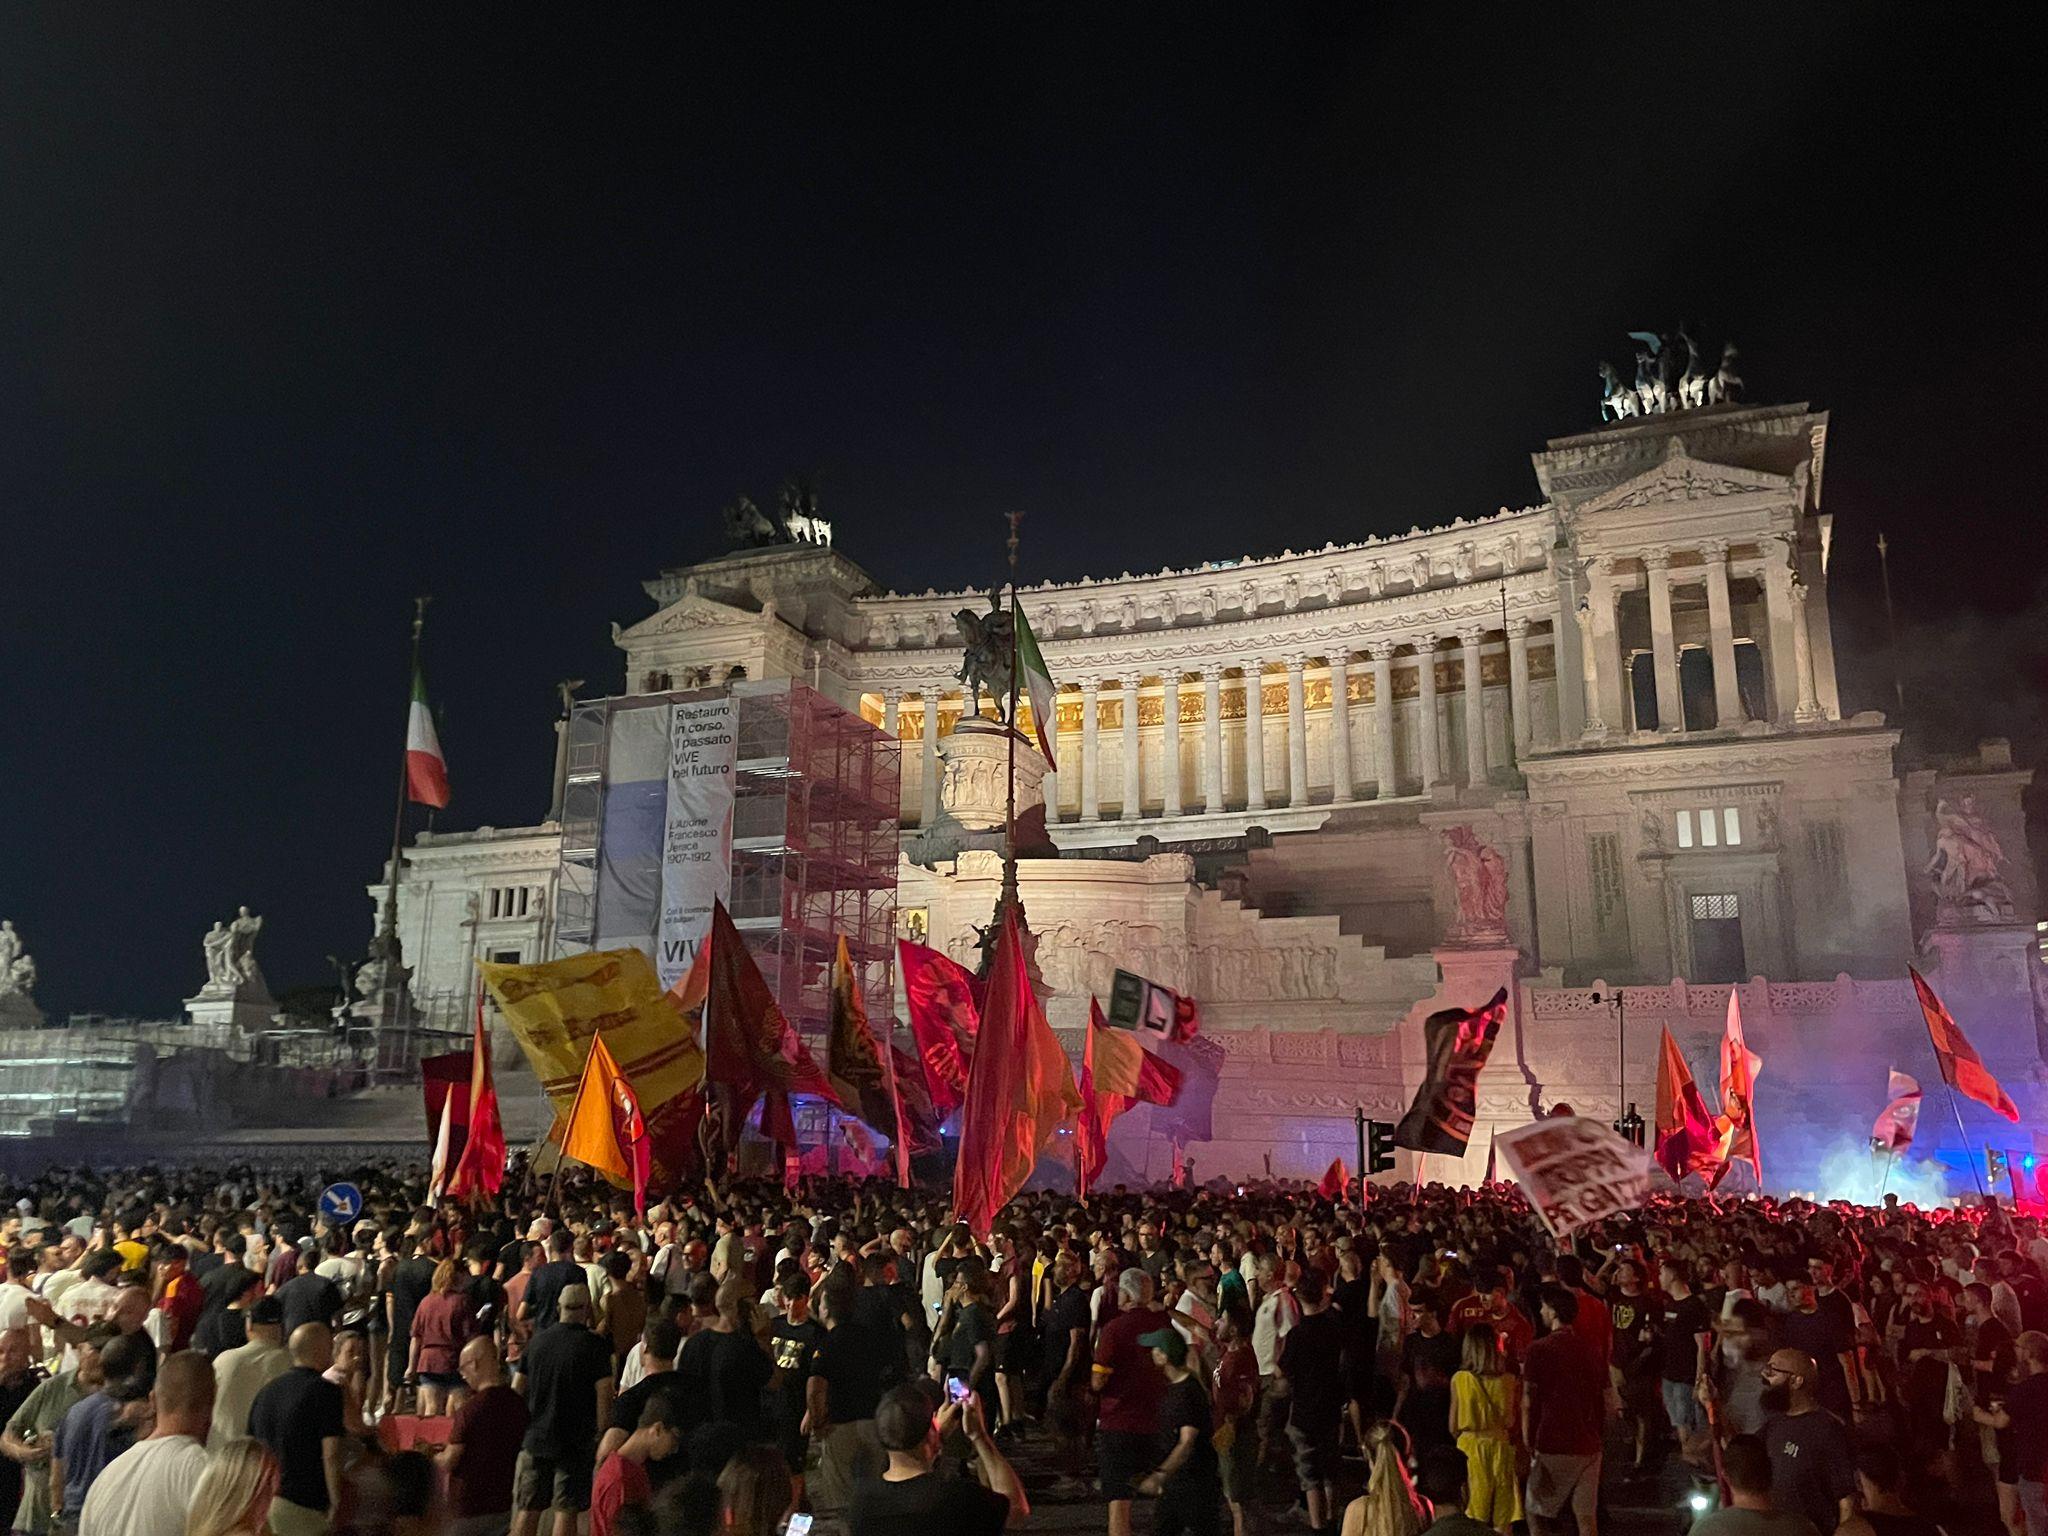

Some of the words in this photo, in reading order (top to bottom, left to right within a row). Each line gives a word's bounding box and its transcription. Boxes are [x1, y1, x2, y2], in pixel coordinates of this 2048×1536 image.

[677, 707, 729, 720] Restauro
[688, 721, 725, 733] corso.
[683, 734, 731, 750] passato
[675, 751, 699, 765] VIVE
[673, 766, 688, 779] nel
[692, 765, 729, 777] futuro
[669, 829, 718, 841] Francesco
[664, 940, 702, 962] VIV
